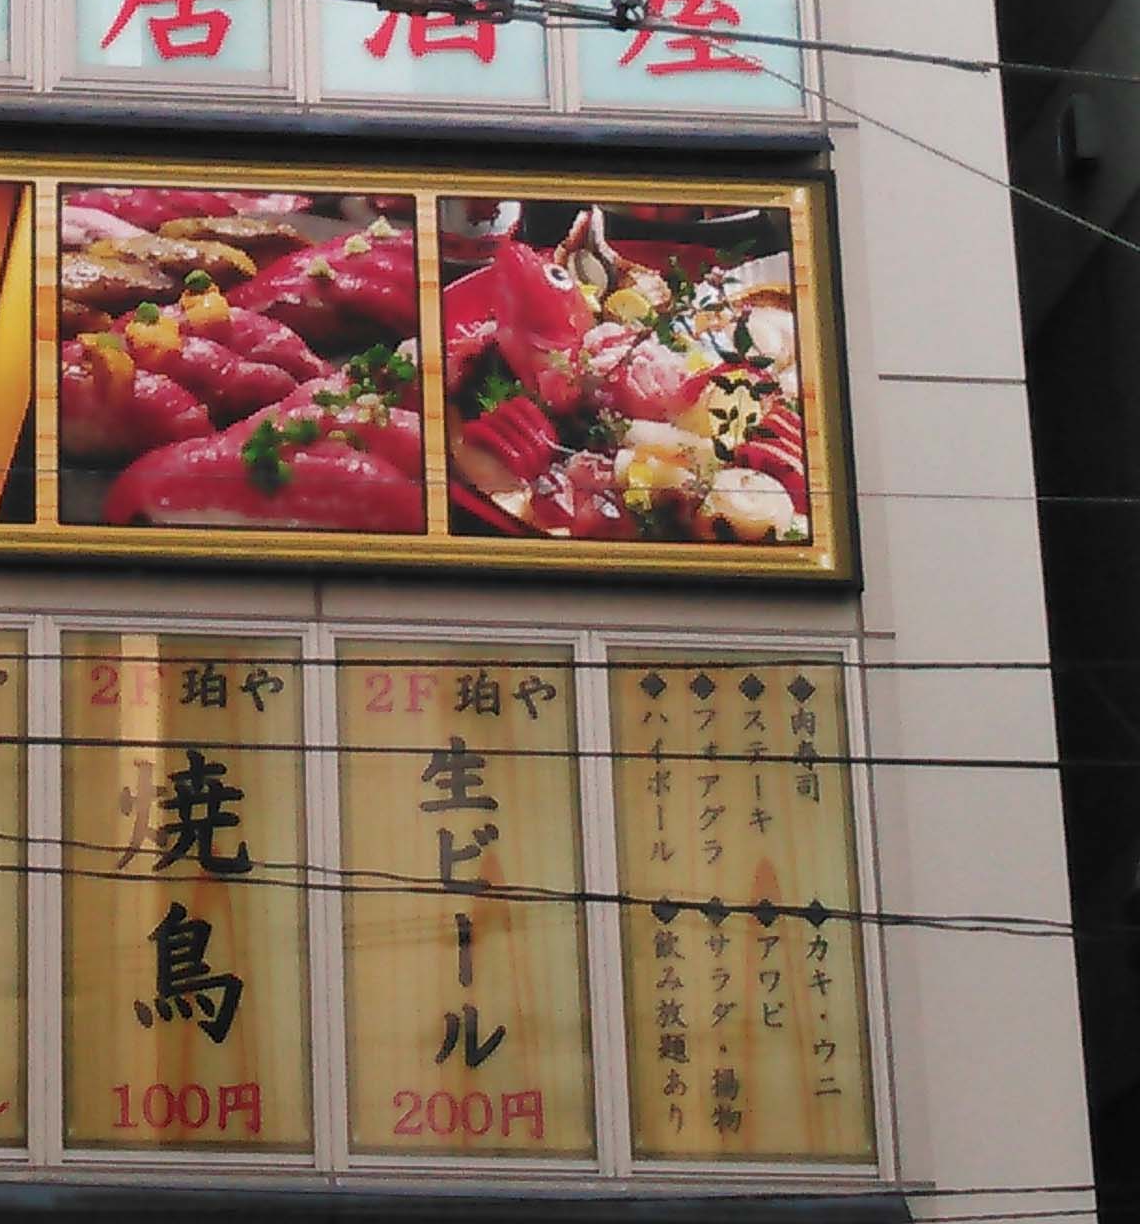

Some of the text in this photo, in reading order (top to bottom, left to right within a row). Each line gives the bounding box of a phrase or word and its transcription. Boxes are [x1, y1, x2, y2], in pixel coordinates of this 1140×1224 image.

[117, 749, 253, 1044] 焼鳥
[420, 736, 506, 1069] 生ビール
[653, 930, 690, 1134] 飲み放題あり
[757, 935, 784, 1028] アワビ
[112, 1082, 261, 1134] 100円
[392, 1089, 545, 1139] 200円
